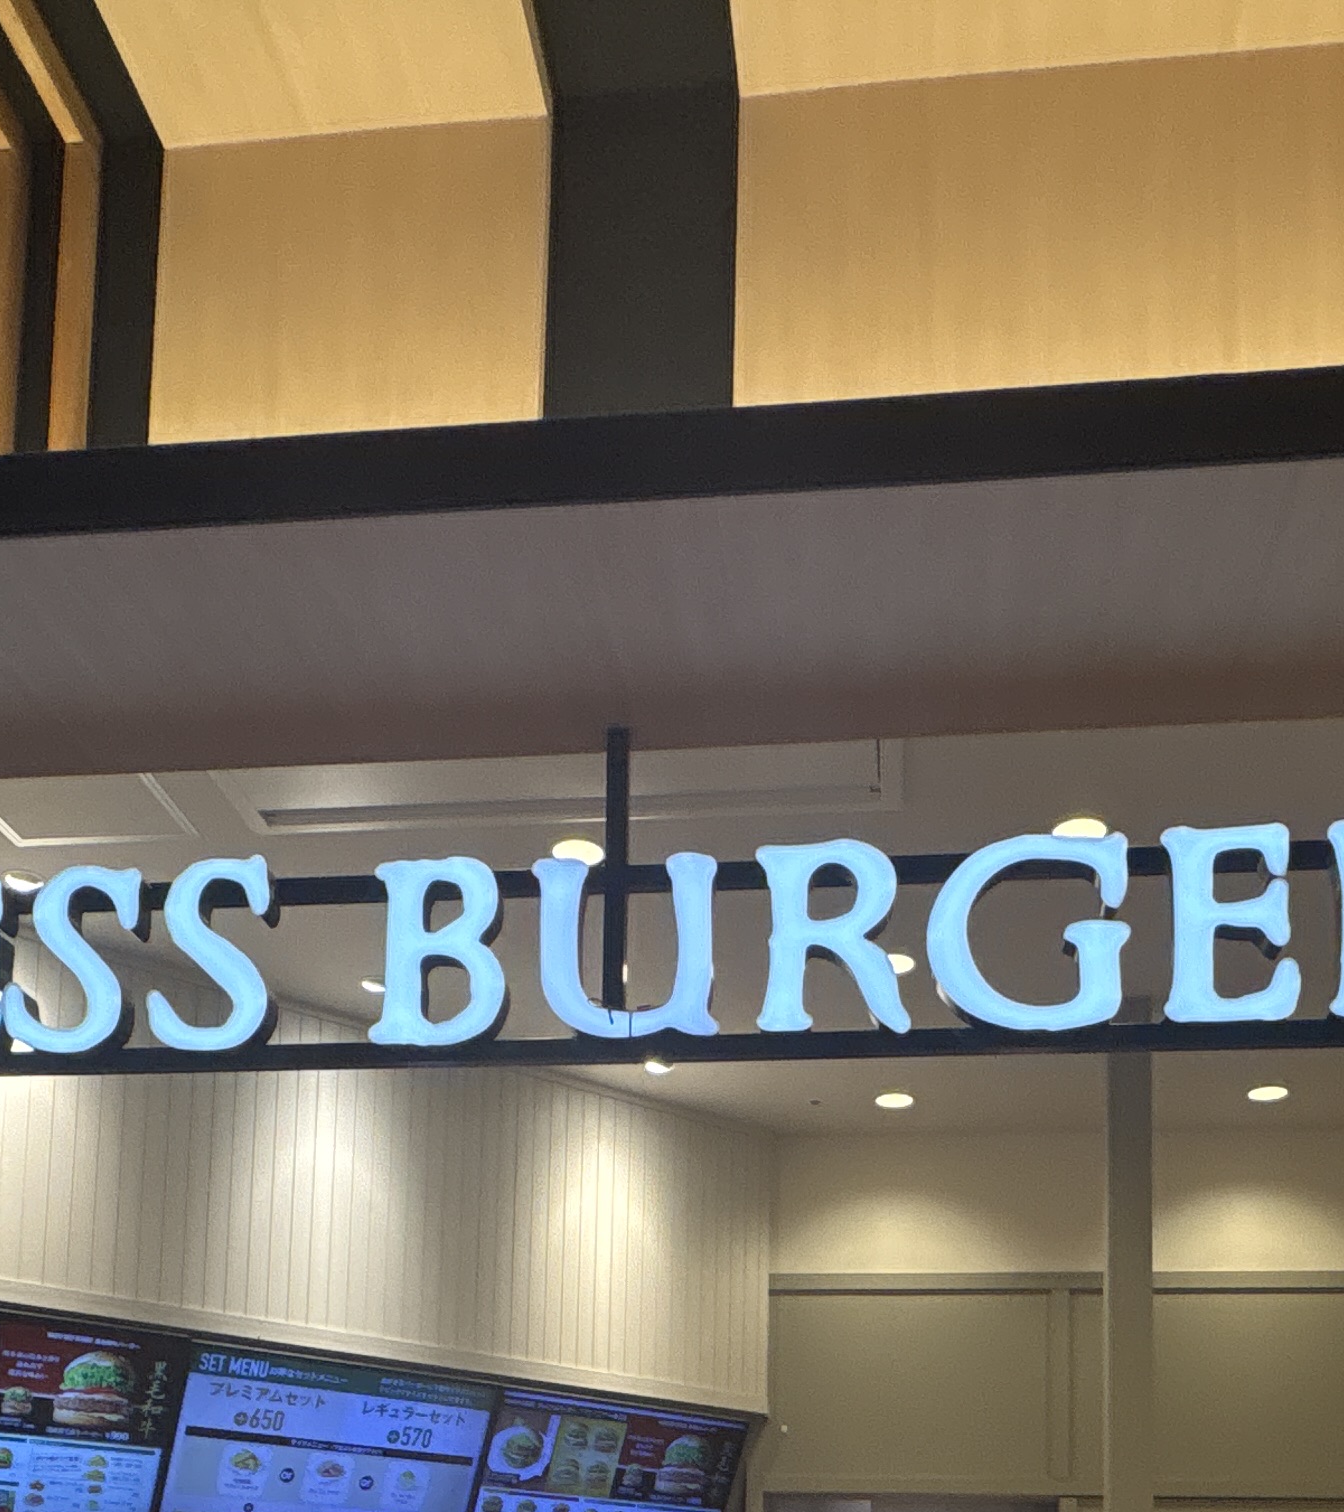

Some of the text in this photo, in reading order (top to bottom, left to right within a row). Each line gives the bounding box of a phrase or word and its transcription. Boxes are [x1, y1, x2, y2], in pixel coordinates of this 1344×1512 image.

[198, 1353, 226, 1372] SET
[228, 1357, 270, 1378] MENU
[209, 1381, 327, 1408] プレミアムセット
[361, 1400, 467, 1425] レギュラーセット
